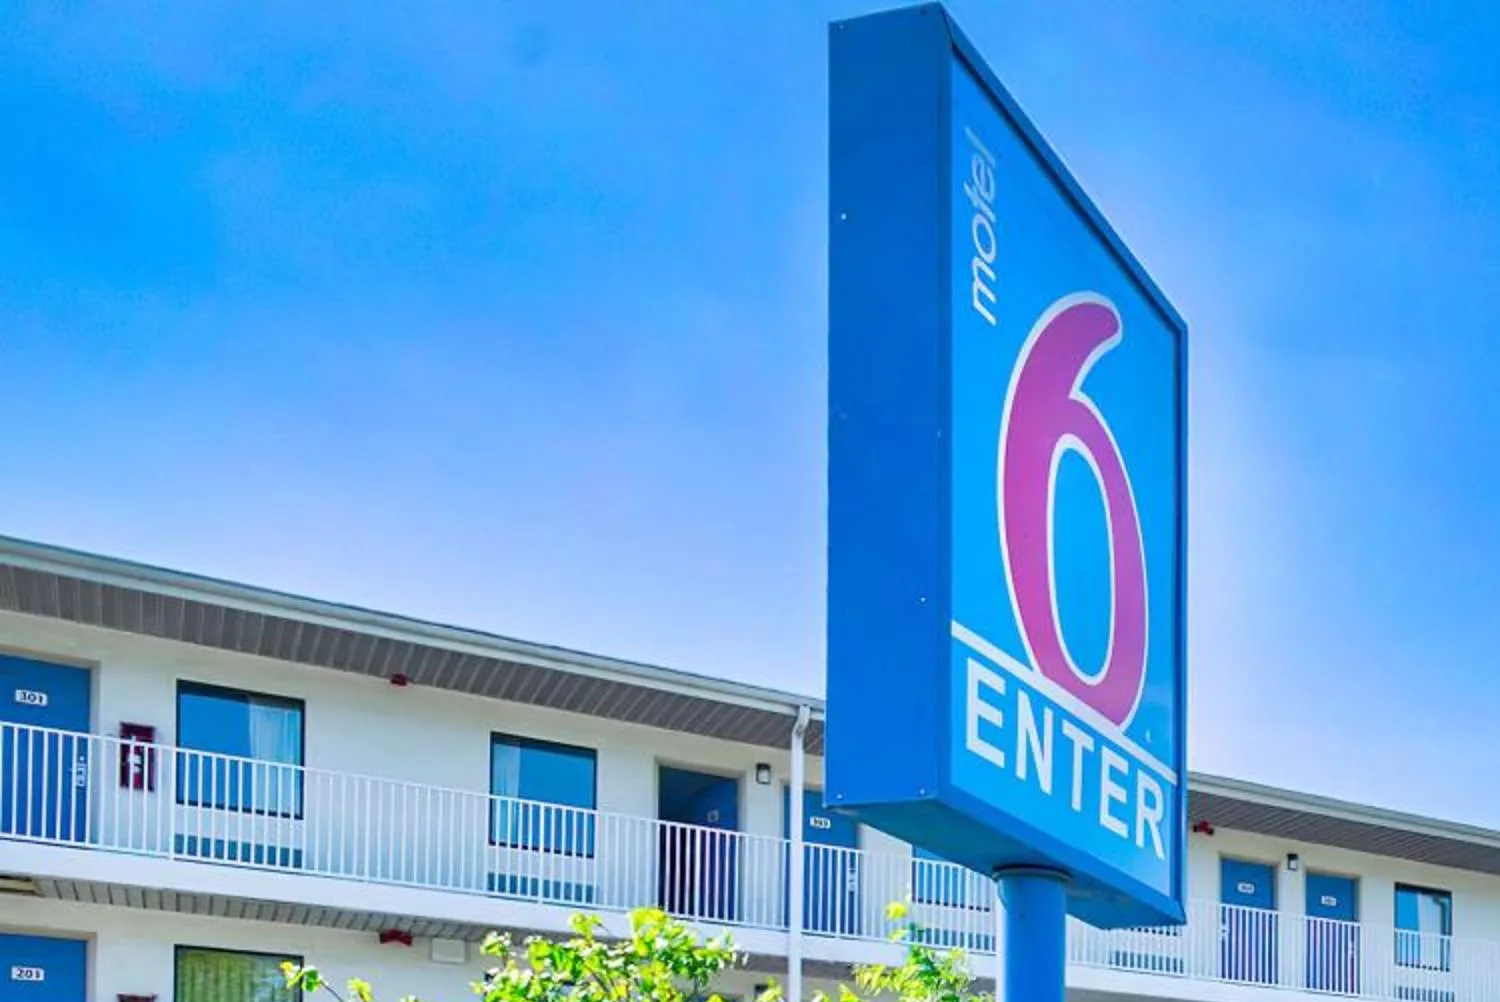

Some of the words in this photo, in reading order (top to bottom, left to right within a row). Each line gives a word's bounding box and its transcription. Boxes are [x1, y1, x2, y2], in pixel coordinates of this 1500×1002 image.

[963, 125, 998, 327] motel
[997, 290, 1149, 732] 6
[966, 657, 1166, 861] ENTER
[14, 967, 41, 979] 201
